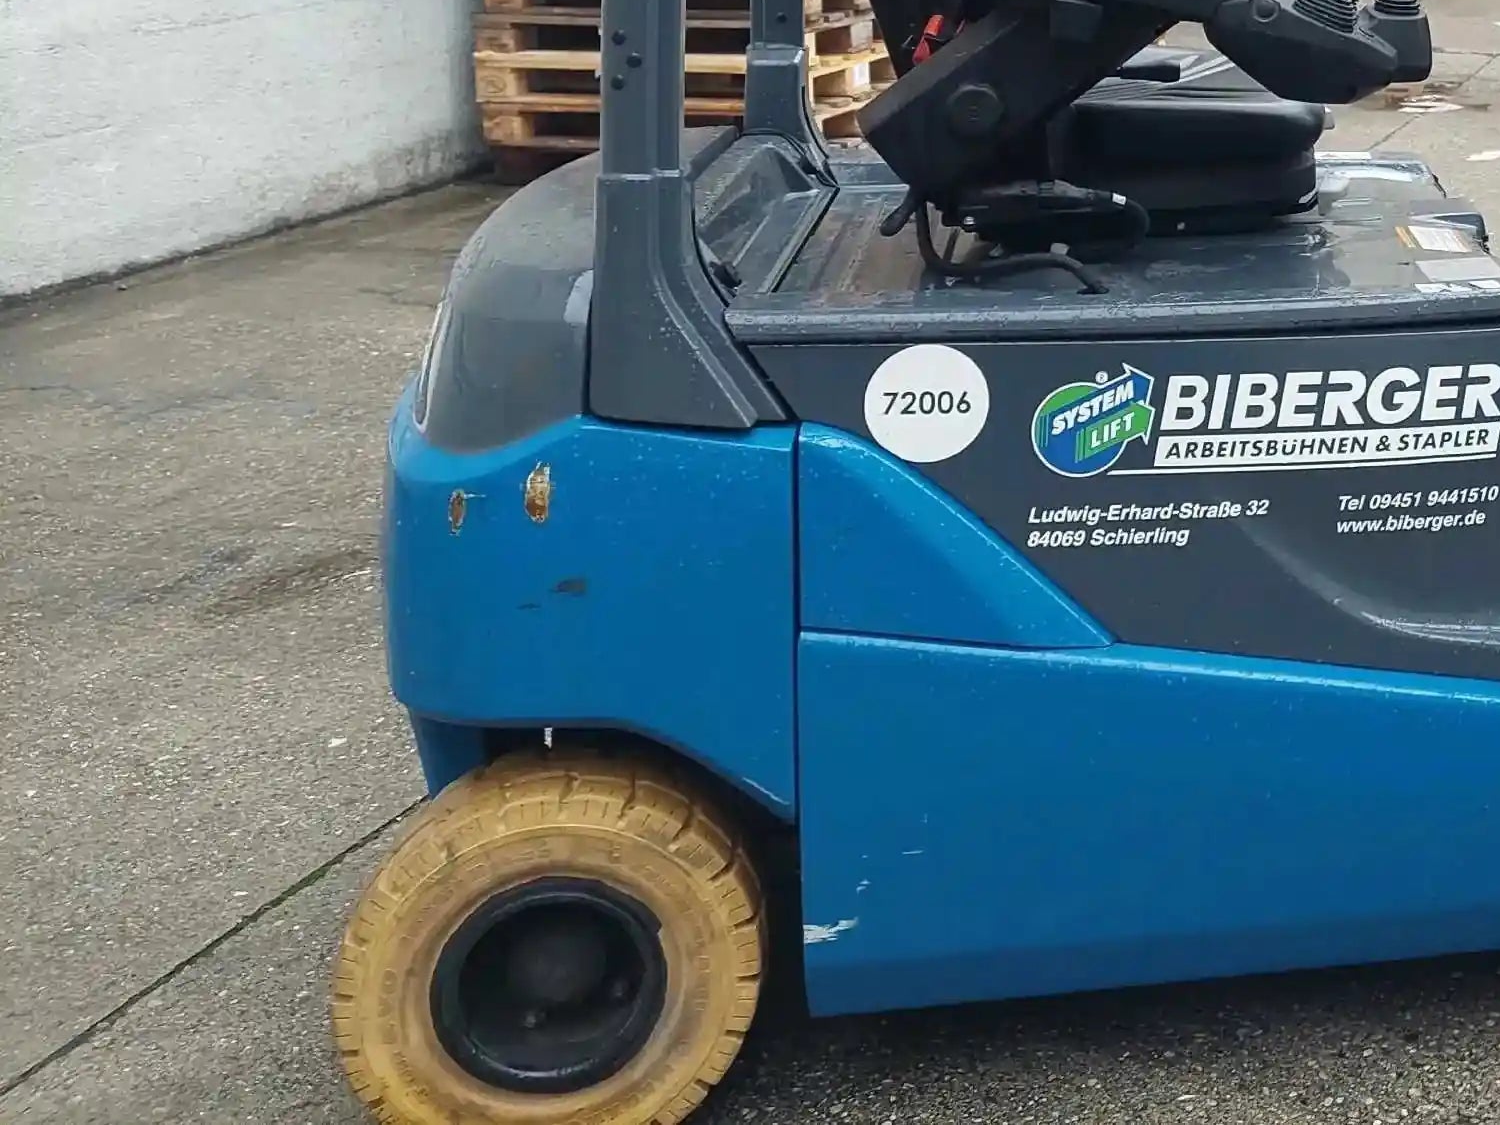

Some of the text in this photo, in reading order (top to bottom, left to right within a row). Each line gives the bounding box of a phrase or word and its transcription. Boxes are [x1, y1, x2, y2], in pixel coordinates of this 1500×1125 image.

[882, 390, 972, 415] 72006
[1051, 380, 1135, 435] SYSTEM
[1091, 412, 1135, 448] LIFT
[1165, 427, 1490, 460] ARBEITSBÜHNEN & STAPLER
[1338, 485, 1499, 511] Tel 09451 9441510
[1027, 499, 1270, 526] Ludwig-Erhard-Straße 32
[1336, 509, 1486, 533] www.biberger.de
[1027, 527, 1190, 548] 84069 Schierling
